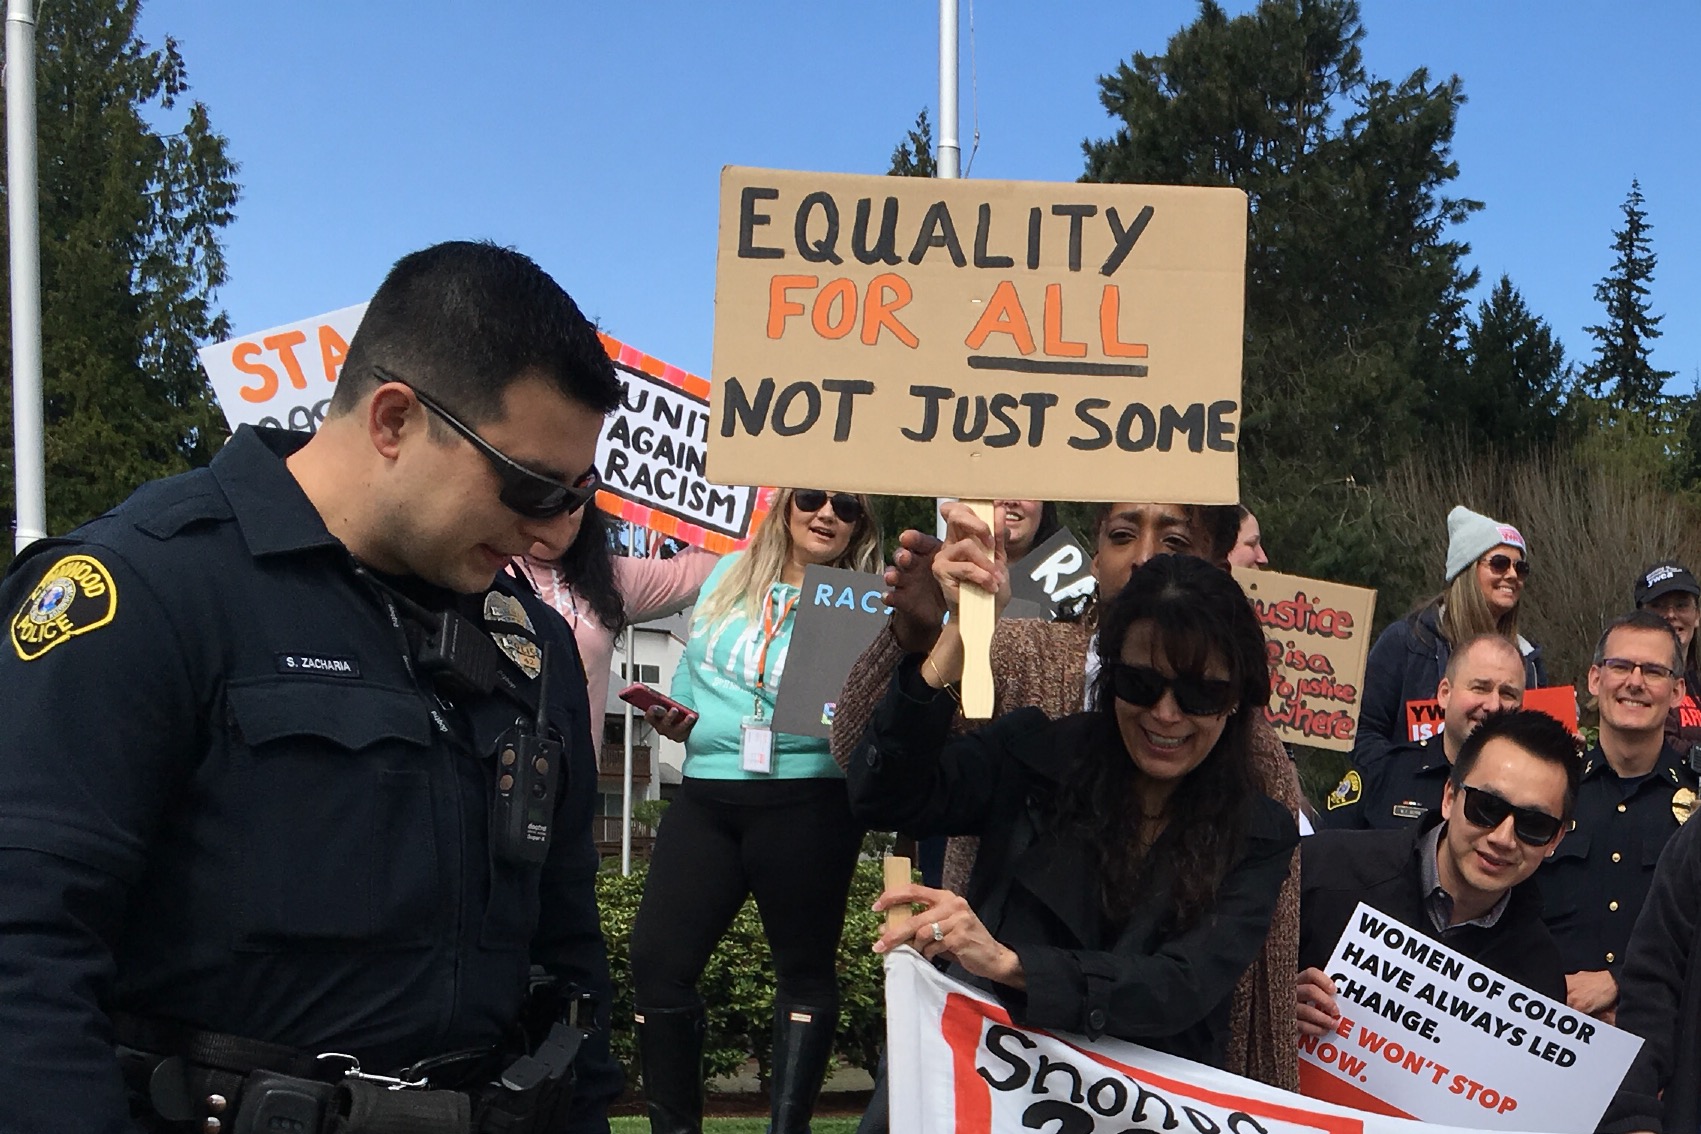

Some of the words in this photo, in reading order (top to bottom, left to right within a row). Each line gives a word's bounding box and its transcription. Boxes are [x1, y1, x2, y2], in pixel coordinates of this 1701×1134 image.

[737, 187, 1154, 276] EQUALITY
[767, 273, 919, 349] FOR
[965, 281, 1149, 357] ALL
[721, 377, 874, 442] NOT
[901, 385, 1058, 449] JUST
[1068, 400, 1238, 453] SOME
[604, 448, 736, 524] RACISM
[17, 613, 74, 643] POLICE
[814, 583, 896, 616] RAC
[1250, 591, 1354, 639] ustice
[286, 657, 299, 667] S.
[301, 657, 351, 672] ZACHARIA
[1285, 640, 1307, 671] is
[1307, 653, 1334, 675] a
[1286, 676, 1357, 706] justice
[1412, 724, 1433, 742] IS
[1330, 972, 1441, 1044] CHANGE.
[1341, 942, 1415, 992] HAVE
[1414, 983, 1528, 1047] ALWAYS
[1527, 1037, 1577, 1068] LED
[1358, 912, 1463, 982] WOMEN
[1467, 971, 1507, 1000] OF
[1507, 992, 1596, 1045] COLOR
[1298, 1035, 1368, 1083] NOW.
[1358, 1027, 1450, 1085] WON'T
[1448, 1074, 1518, 1115] STOP
